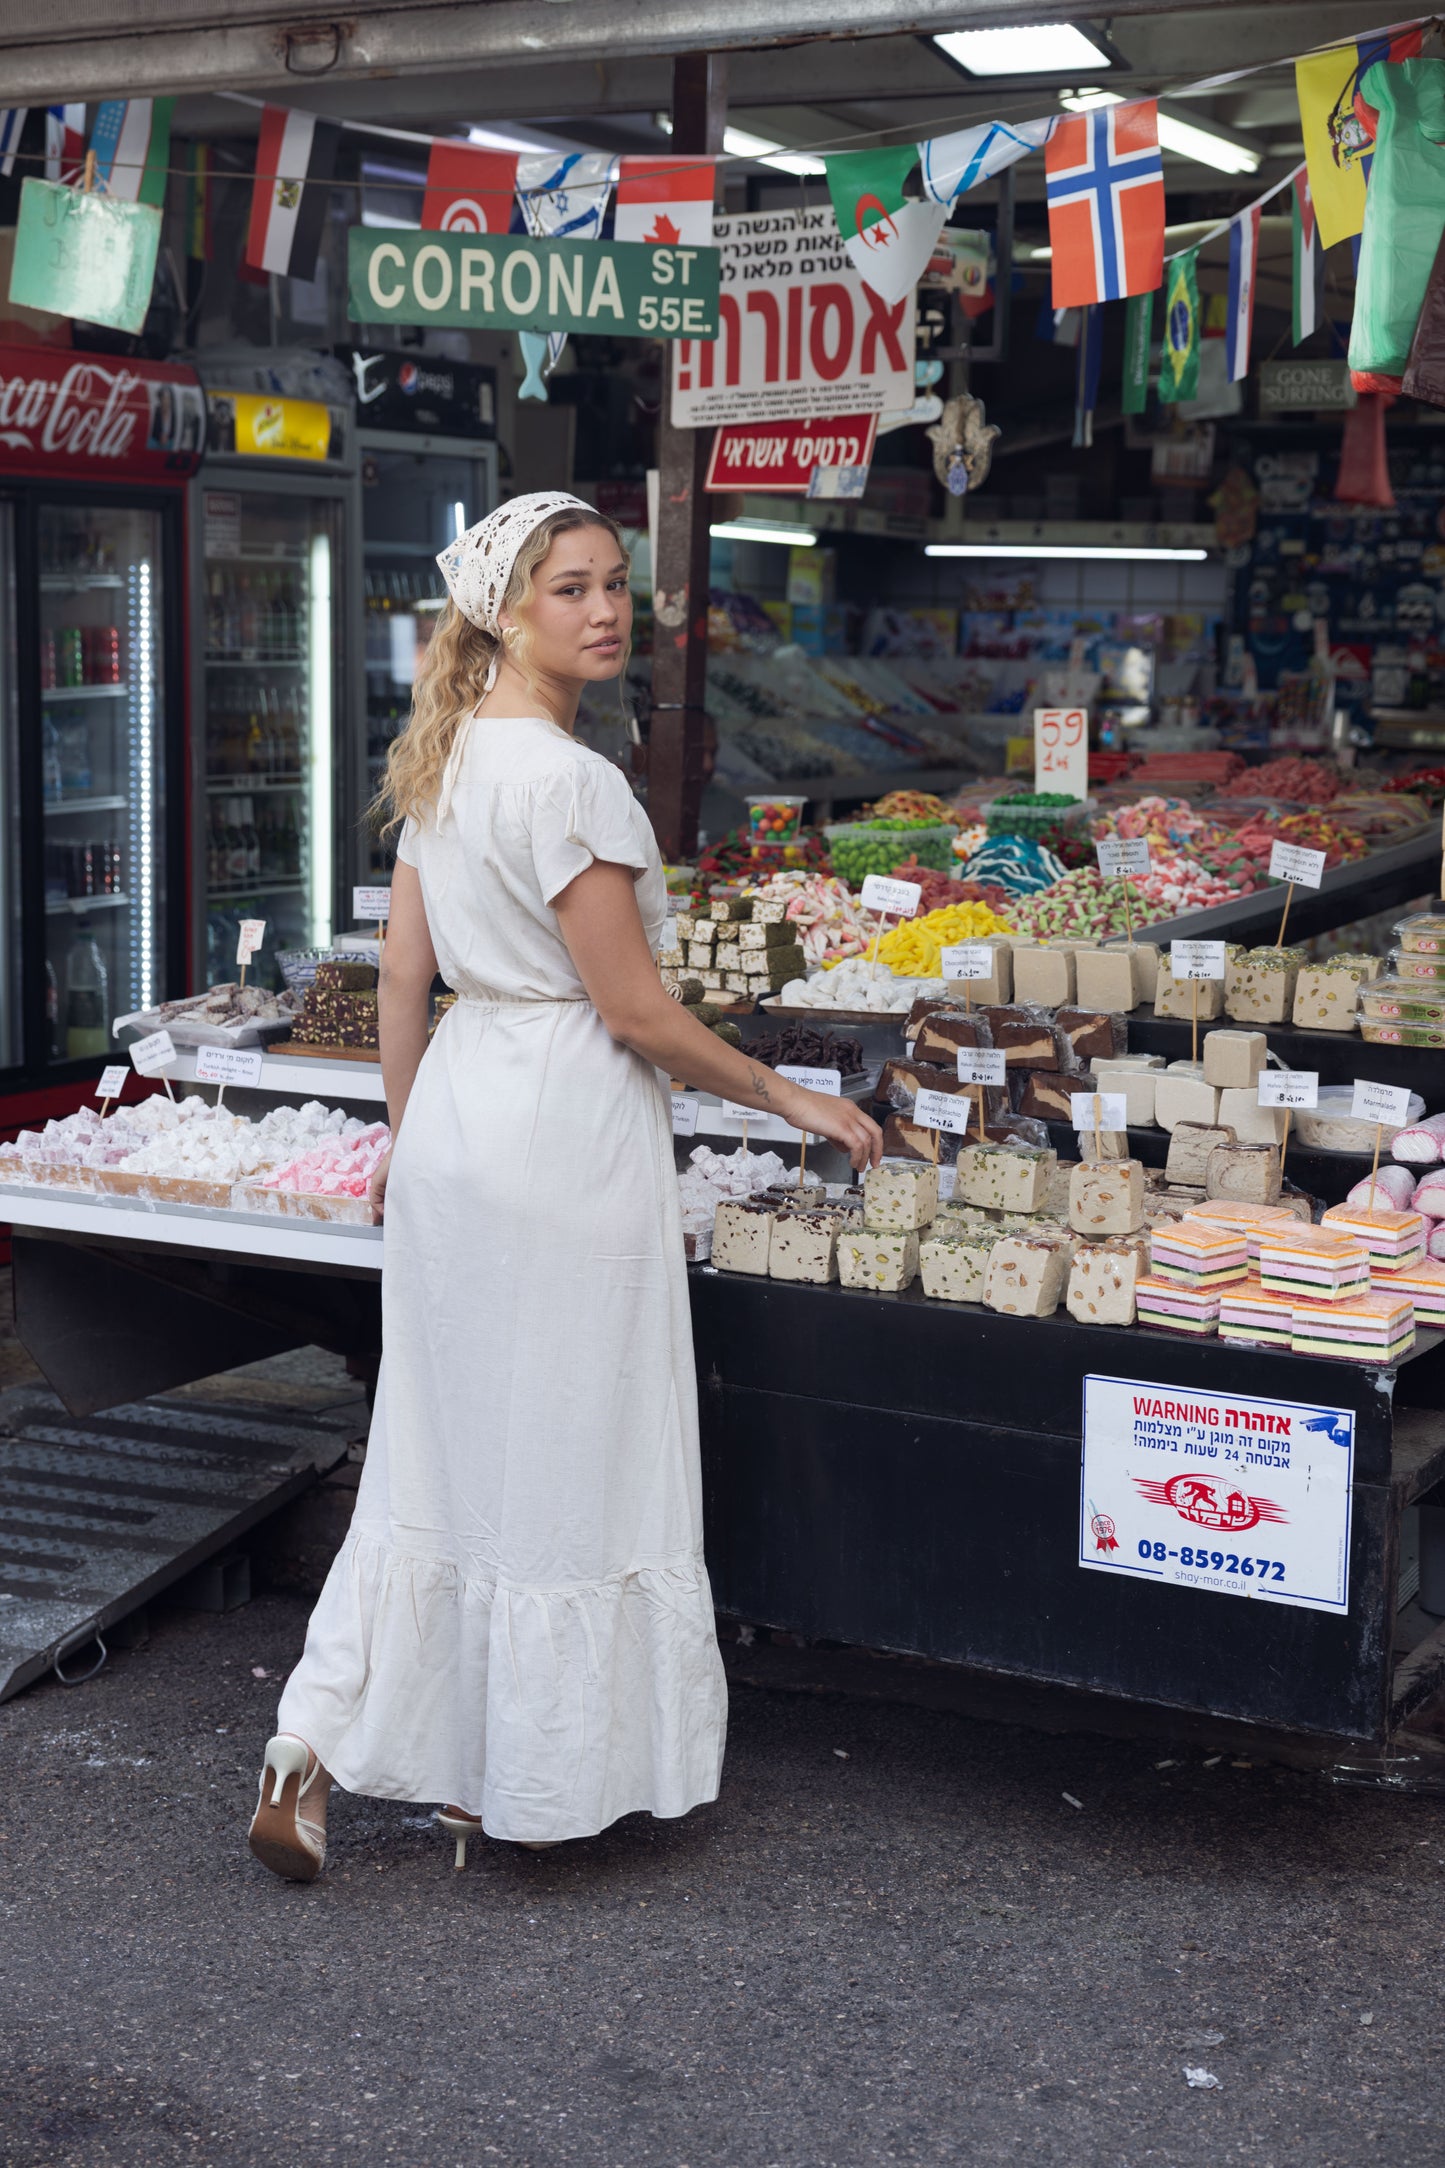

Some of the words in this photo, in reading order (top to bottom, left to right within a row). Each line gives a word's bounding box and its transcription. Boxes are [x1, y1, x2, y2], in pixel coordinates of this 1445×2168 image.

[713, 222, 730, 238] ש
[737, 217, 795, 236] הגשה
[803, 214, 824, 229] או
[743, 260, 793, 279] מלאו
[368, 243, 624, 319] CORONA
[652, 249, 697, 285] ST
[638, 295, 712, 333] 55E.
[1277, 367, 1332, 385] GONE
[1265, 385, 1345, 403] SURFING
[723, 437, 789, 468] אשראי
[1042, 711, 1083, 748] 59
[816, 1079, 834, 1087] חלבה
[972, 1072, 977, 1081] 8
[1279, 1093, 1285, 1101] 8
[1363, 1098, 1397, 1111] Marmalade
[671, 1101, 685, 1113] לוקו
[1133, 1396, 1219, 1426] WARNING
[1133, 1419, 1182, 1437] מצלמות
[1224, 1408, 1292, 1435] אזהרה
[1133, 1434, 1178, 1452] ביממה!
[1209, 1430, 1234, 1446] מוגן
[1238, 1436, 1253, 1447] זה
[1257, 1438, 1291, 1453] מקום
[1184, 1442, 1218, 1458] שעות
[1224, 1449, 1239, 1462] 24
[1245, 1451, 1290, 1469] אבטחה
[1095, 1524, 1113, 1535] 1976
[1138, 1538, 1286, 1582] 08-8592672
[1174, 1569, 1246, 1591] shay-mor.co.il
